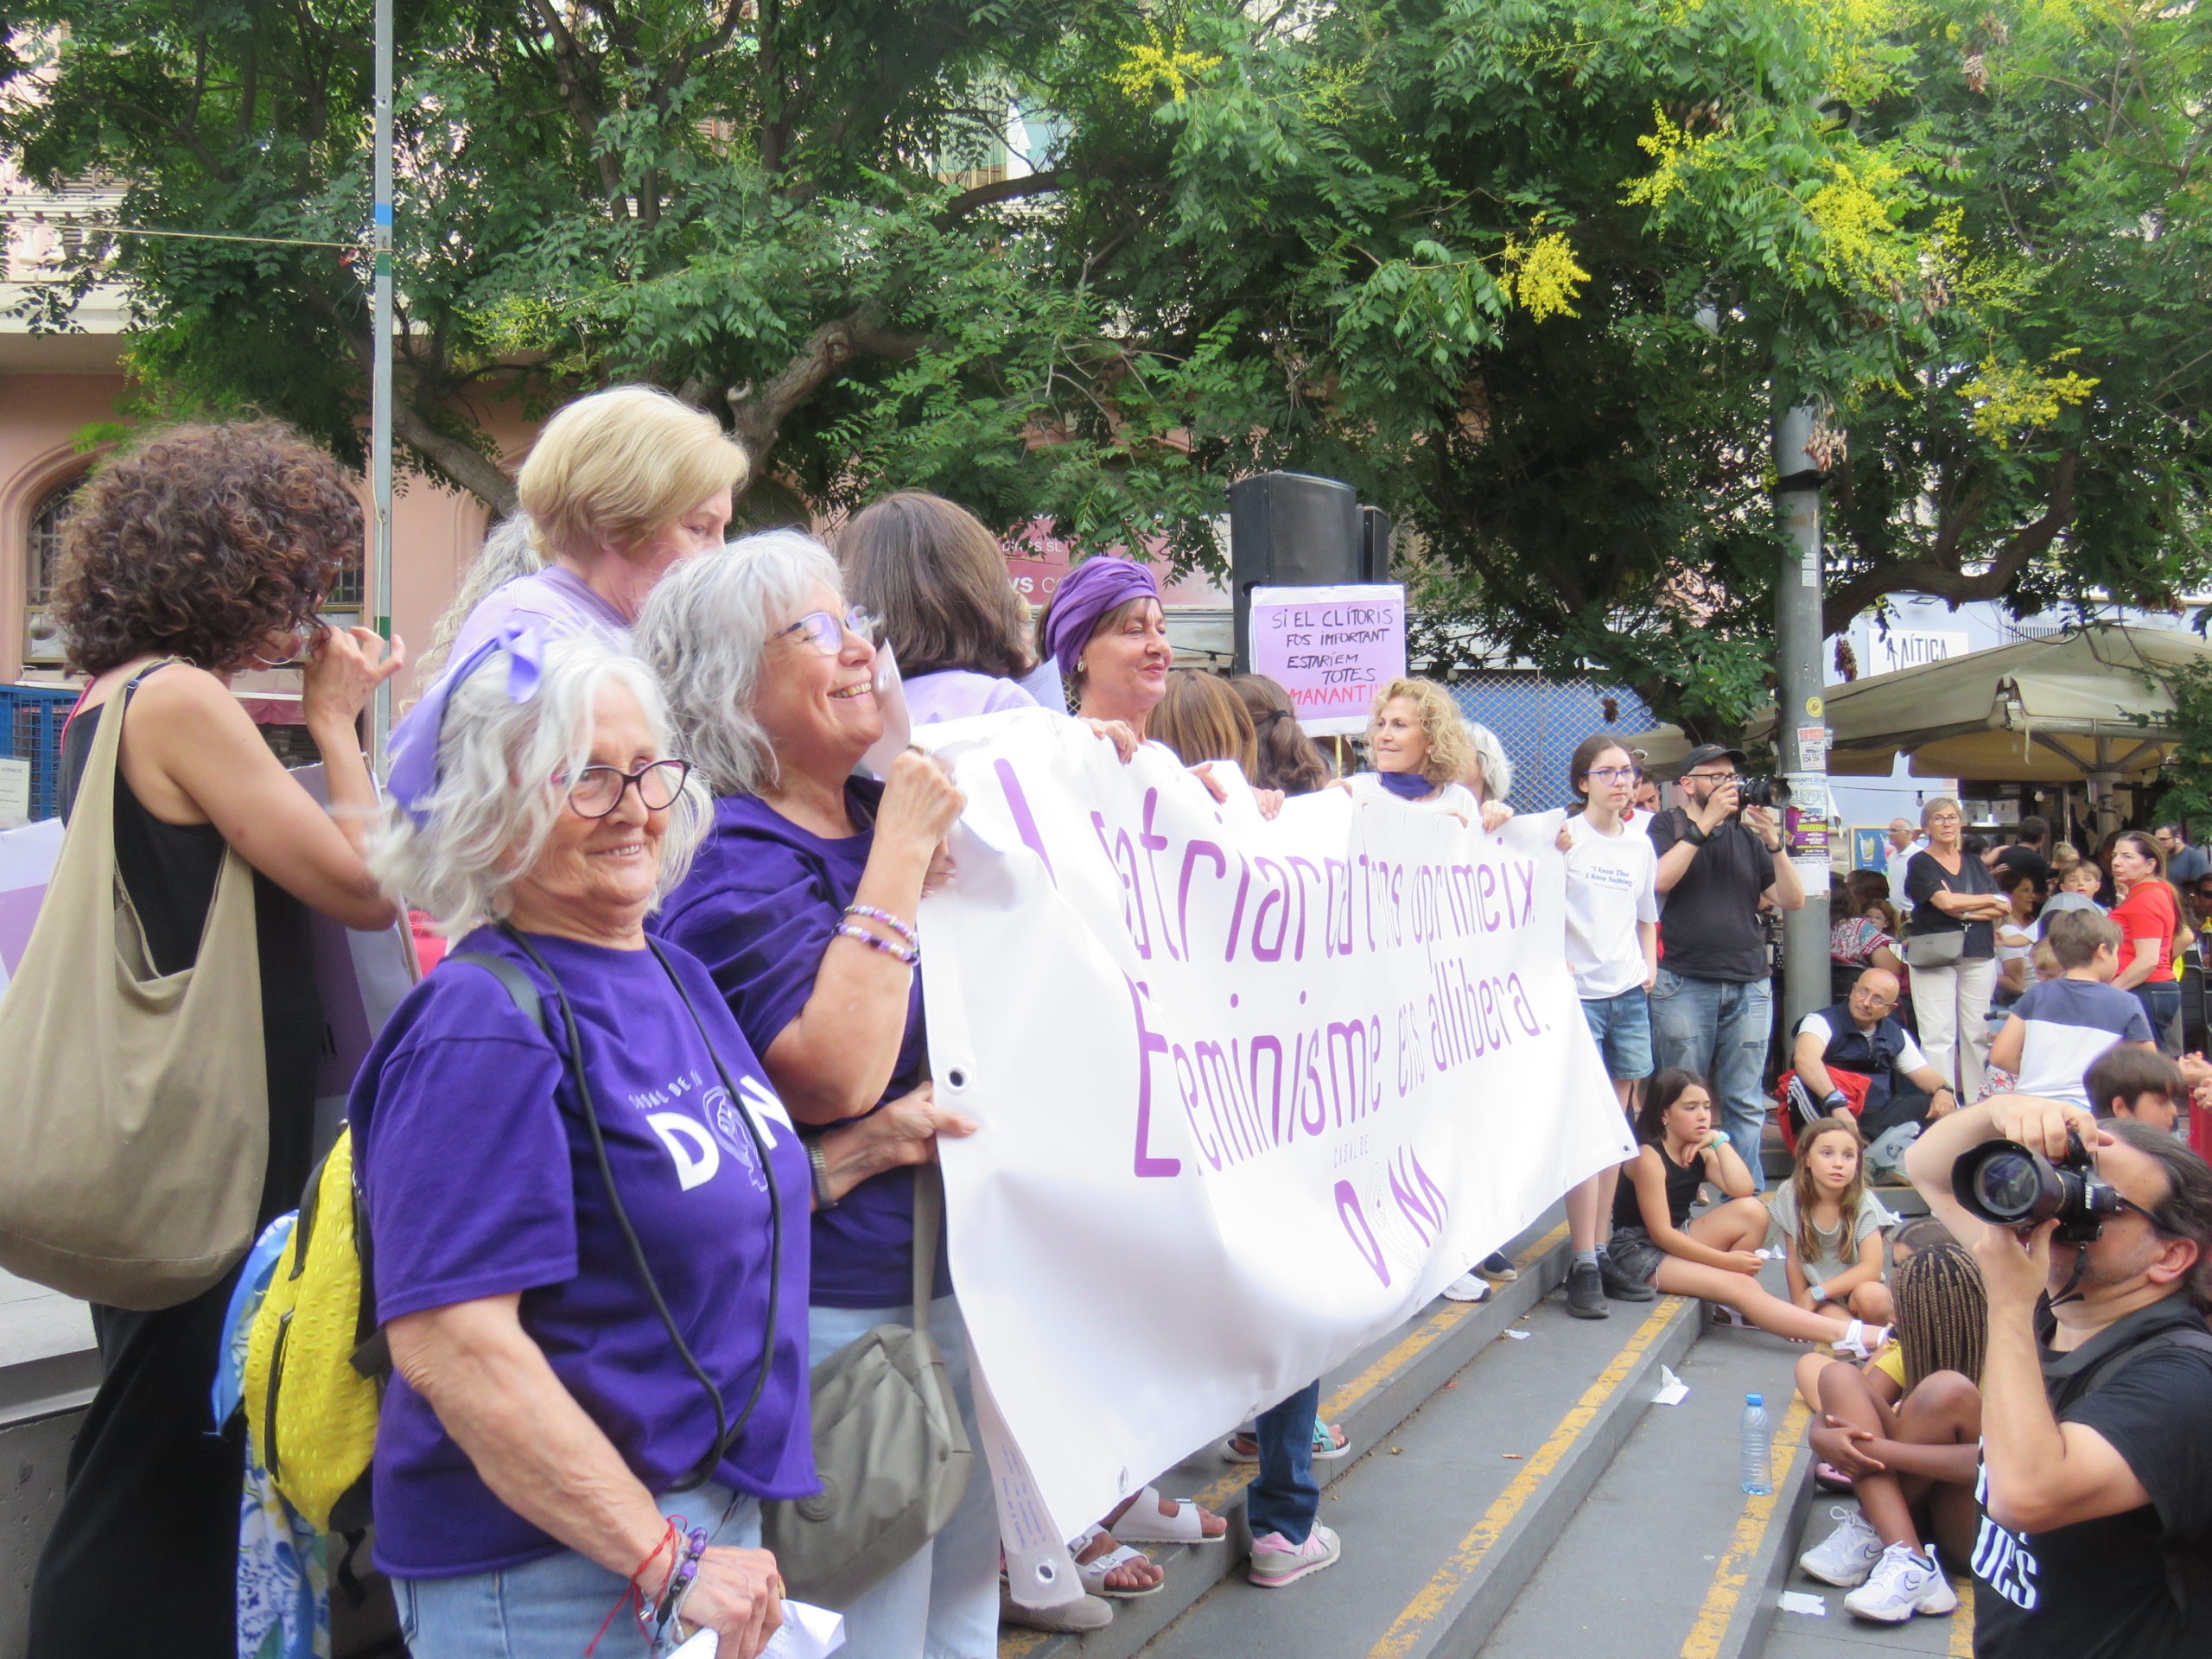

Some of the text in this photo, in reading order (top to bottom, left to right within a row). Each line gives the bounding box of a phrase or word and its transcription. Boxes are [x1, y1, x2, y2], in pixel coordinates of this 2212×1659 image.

[1046, 541, 1062, 552] SL
[1294, 610, 1314, 627] EL
[1287, 633, 1313, 648] FOS
[1321, 667, 1376, 685] TOTES
[1090, 786, 1376, 962] atriarcat
[1398, 1000, 1425, 1098] ens
[1428, 957, 1551, 1071] allibera.
[1359, 1133, 1369, 1156] DE
[2084, 1184, 2093, 1210] Nikon
